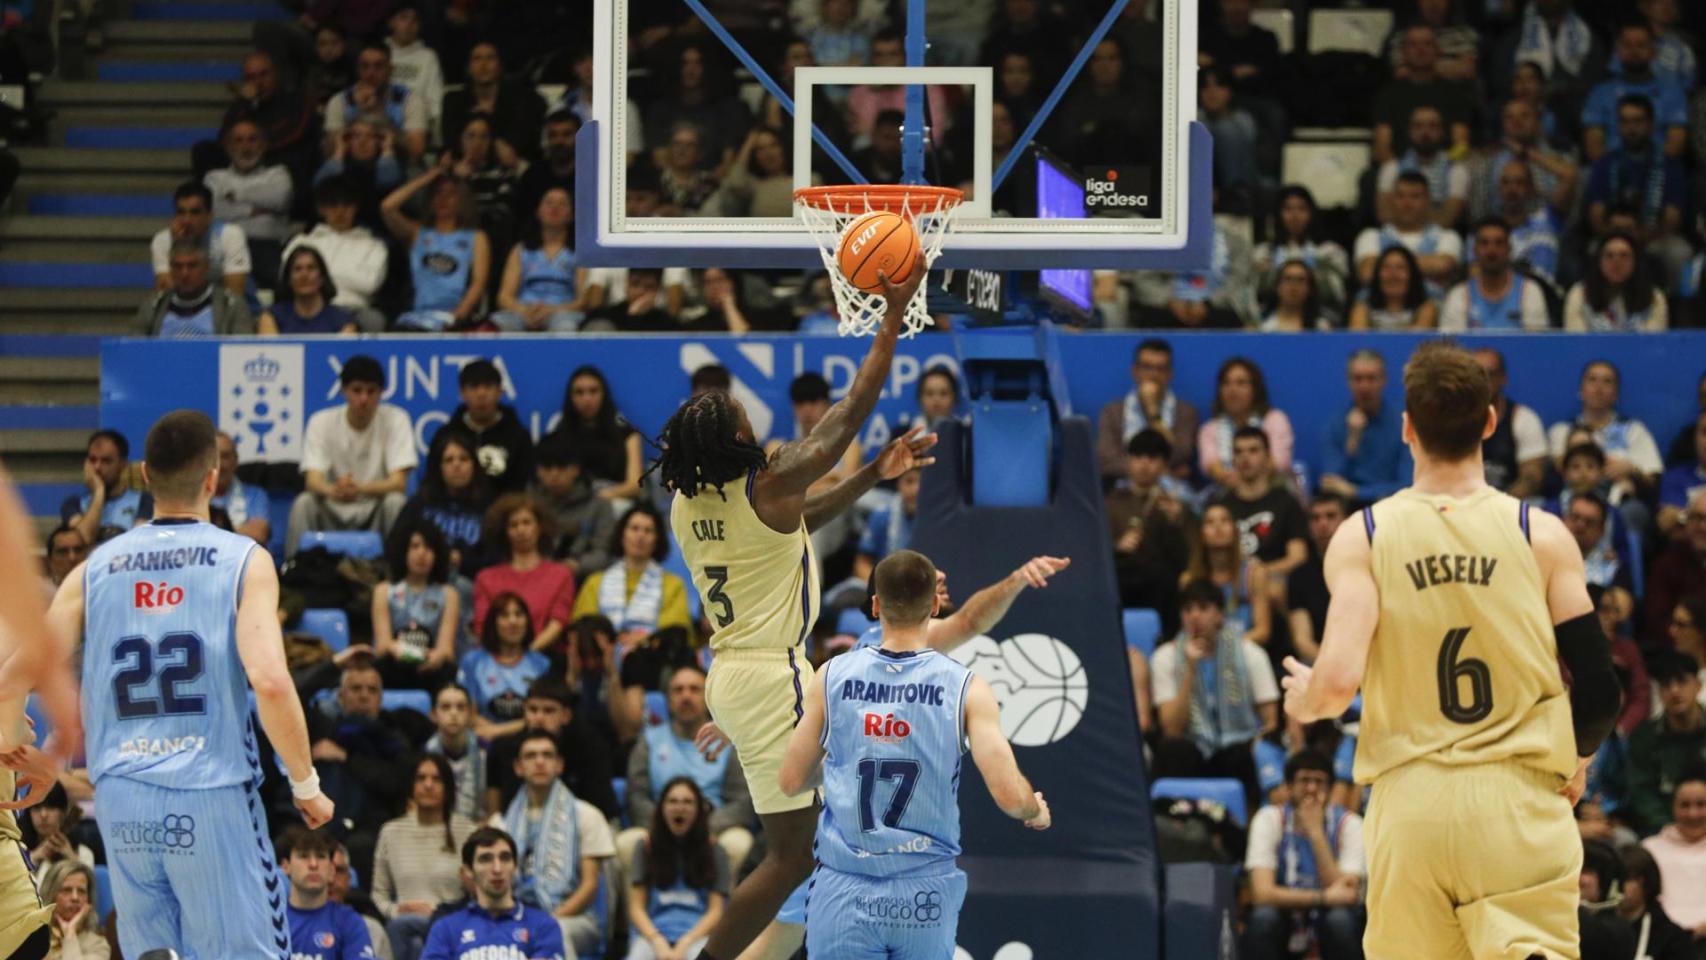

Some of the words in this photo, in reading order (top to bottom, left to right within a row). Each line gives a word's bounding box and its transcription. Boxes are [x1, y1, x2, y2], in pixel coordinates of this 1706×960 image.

[1086, 178, 1115, 194] liga
[1086, 193, 1148, 206] endesa
[692, 519, 725, 541] CALE
[109, 547, 218, 574] BRANKOVIC
[1405, 554, 1497, 591] VESELY
[135, 581, 184, 608] Río
[704, 566, 734, 628] 3
[111, 631, 207, 721] 22
[1437, 626, 1494, 725] 6
[842, 680, 945, 706] ARANITOVIC
[864, 713, 910, 737] Río
[856, 758, 922, 833] 17
[868, 903, 912, 919] LUGO
